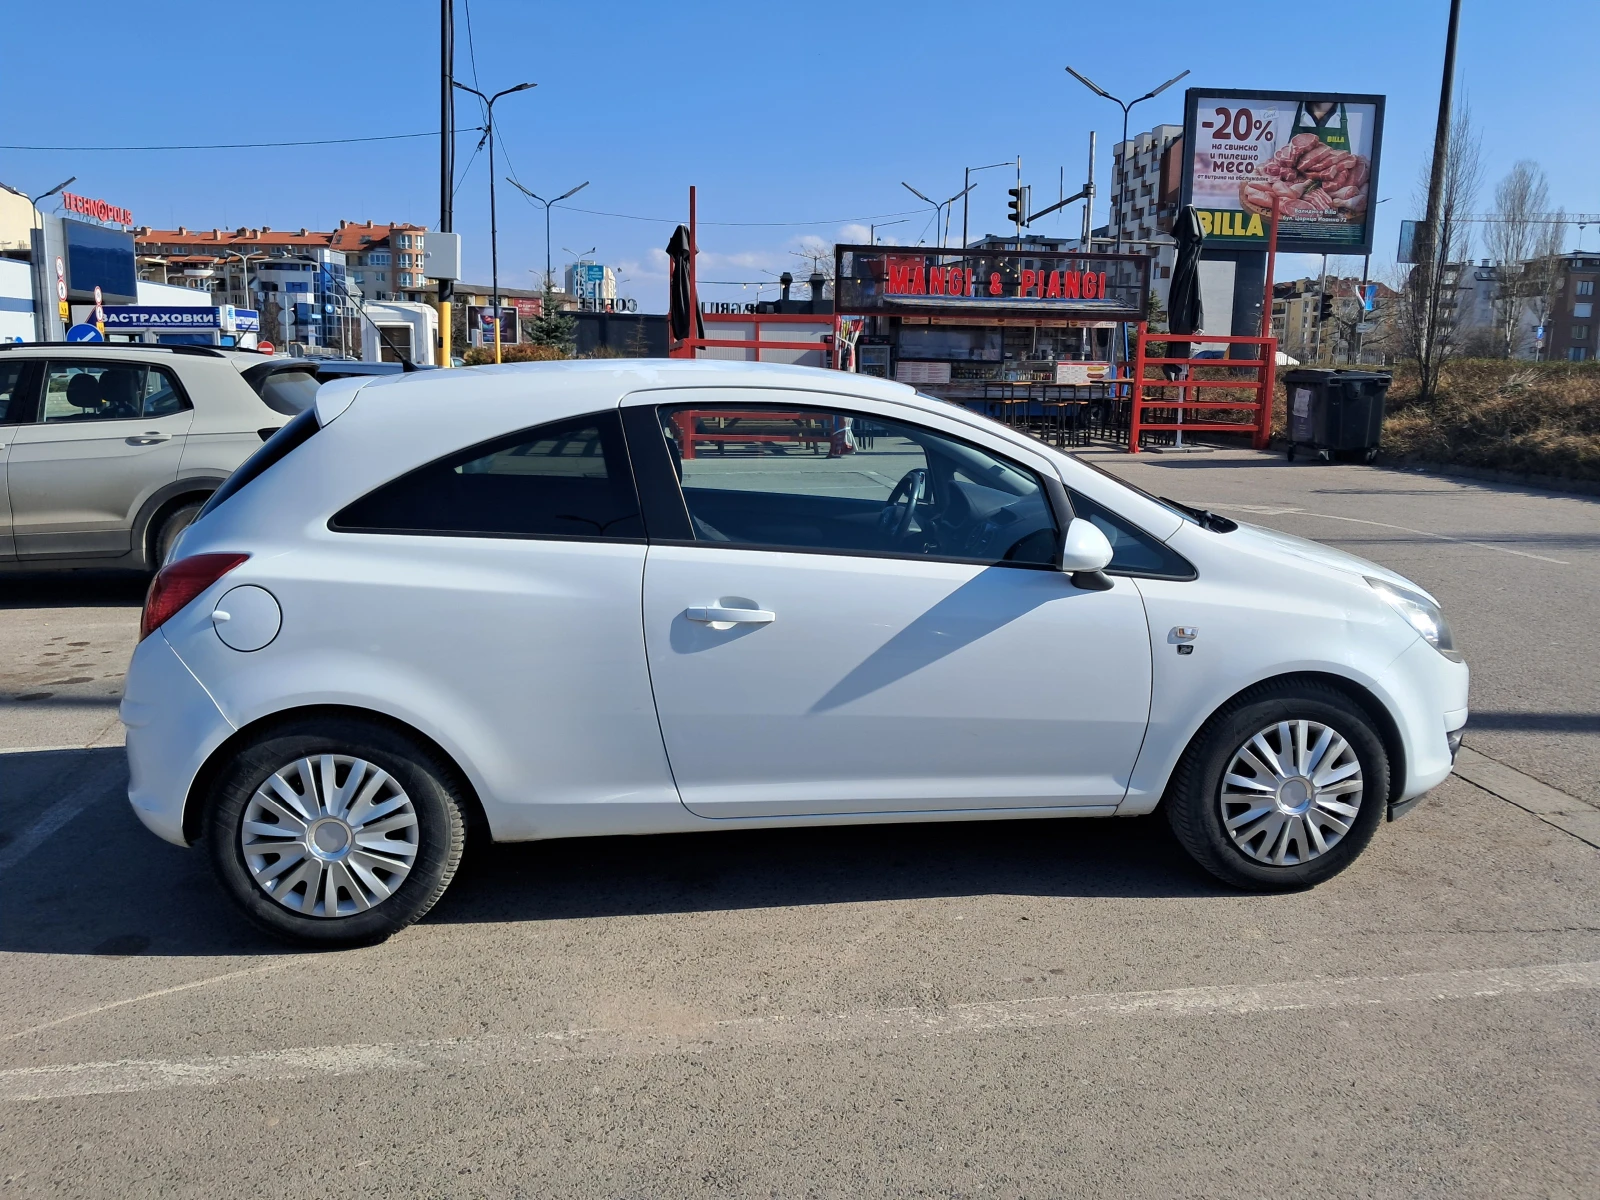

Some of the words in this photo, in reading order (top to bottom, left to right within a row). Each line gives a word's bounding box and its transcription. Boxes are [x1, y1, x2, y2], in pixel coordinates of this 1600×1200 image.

[1202, 107, 1274, 142] -20%
[1327, 135, 1345, 143] BILLA
[1211, 143, 1223, 151] на
[1218, 153, 1259, 161] пилешко
[1212, 161, 1255, 174] месо
[62, 191, 133, 226] TECHNOPOLIS
[1196, 211, 1264, 236] BILLA
[888, 265, 973, 296] MANGI
[989, 272, 1003, 295] &
[1020, 270, 1106, 300] PIANGI
[101, 313, 214, 323] ЗАСТРАХОВКИ
